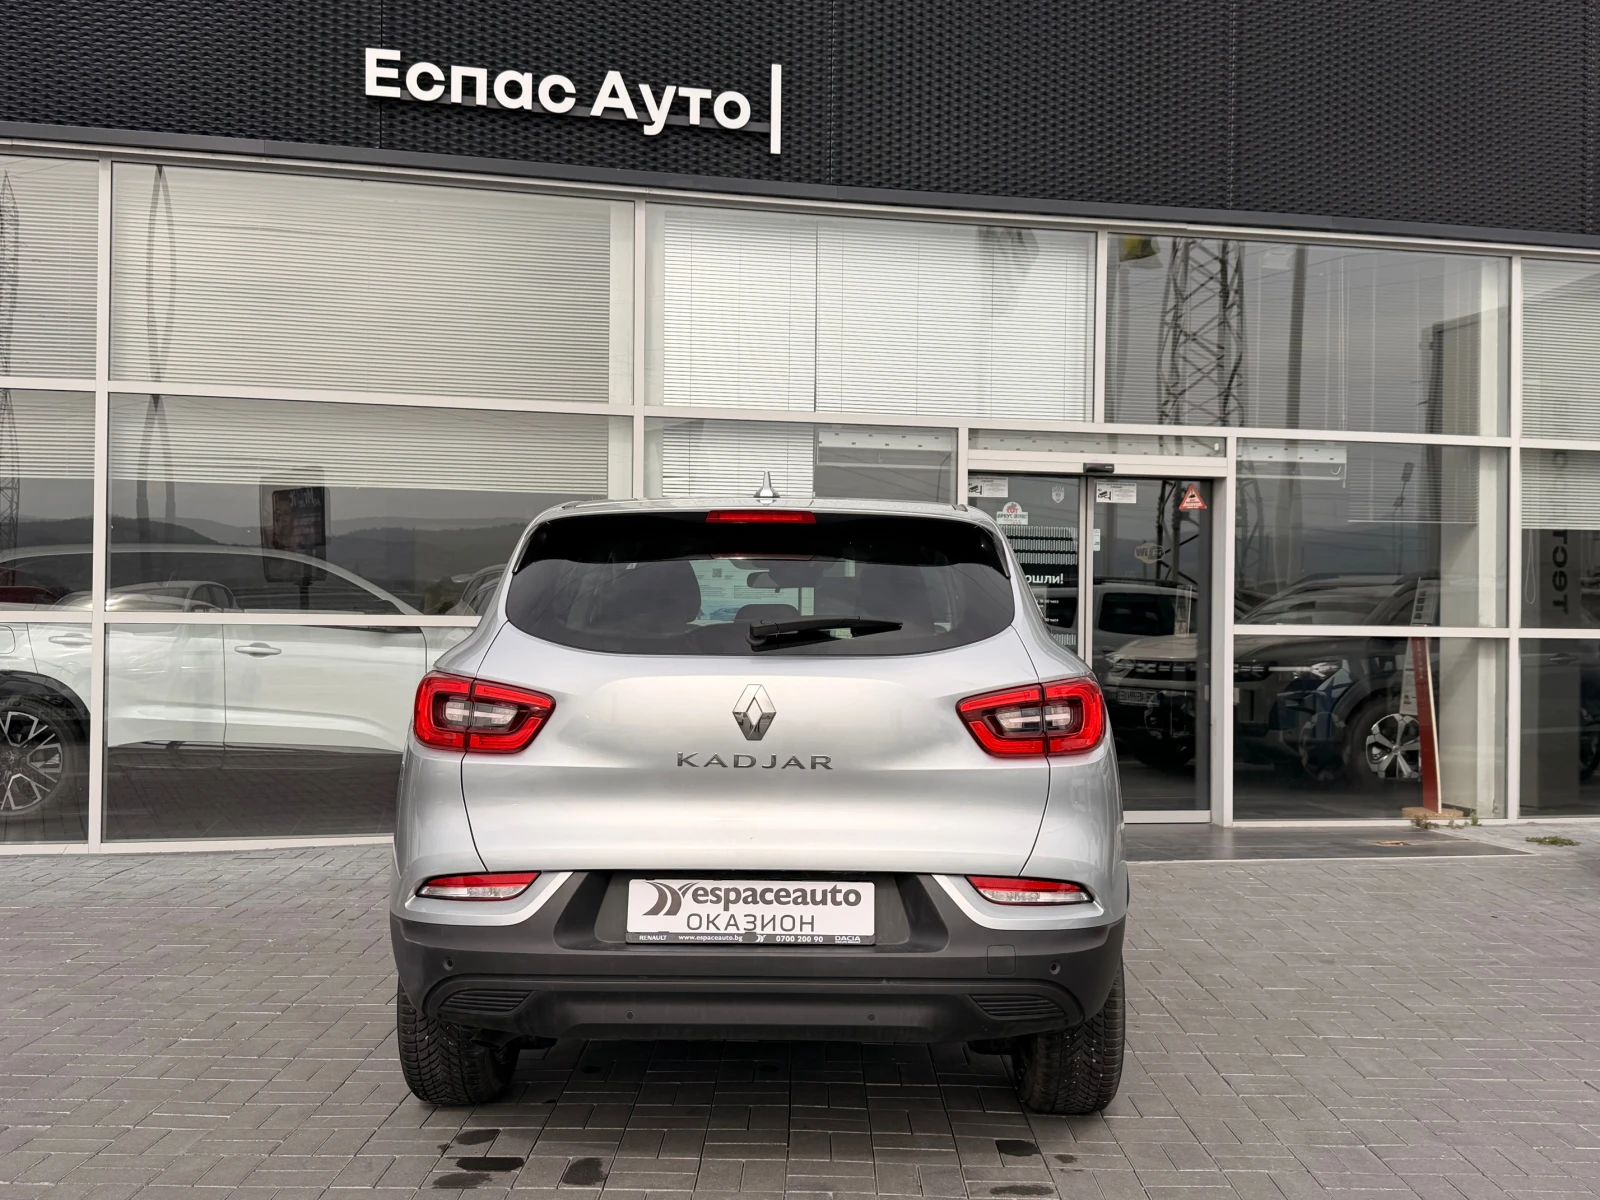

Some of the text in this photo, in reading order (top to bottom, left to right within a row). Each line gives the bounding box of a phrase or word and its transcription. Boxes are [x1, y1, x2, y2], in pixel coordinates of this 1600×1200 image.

[365, 47, 751, 136] Еспас Ауто
[1025, 572, 1064, 585] ошли!
[676, 751, 833, 770] KADJAR
[691, 883, 862, 912] espaceauto
[686, 913, 815, 932] ОКАЗИОН
[678, 934, 743, 943] www.espaceauto.bg
[775, 935, 795, 943] 0700
[797, 935, 812, 943] 200
